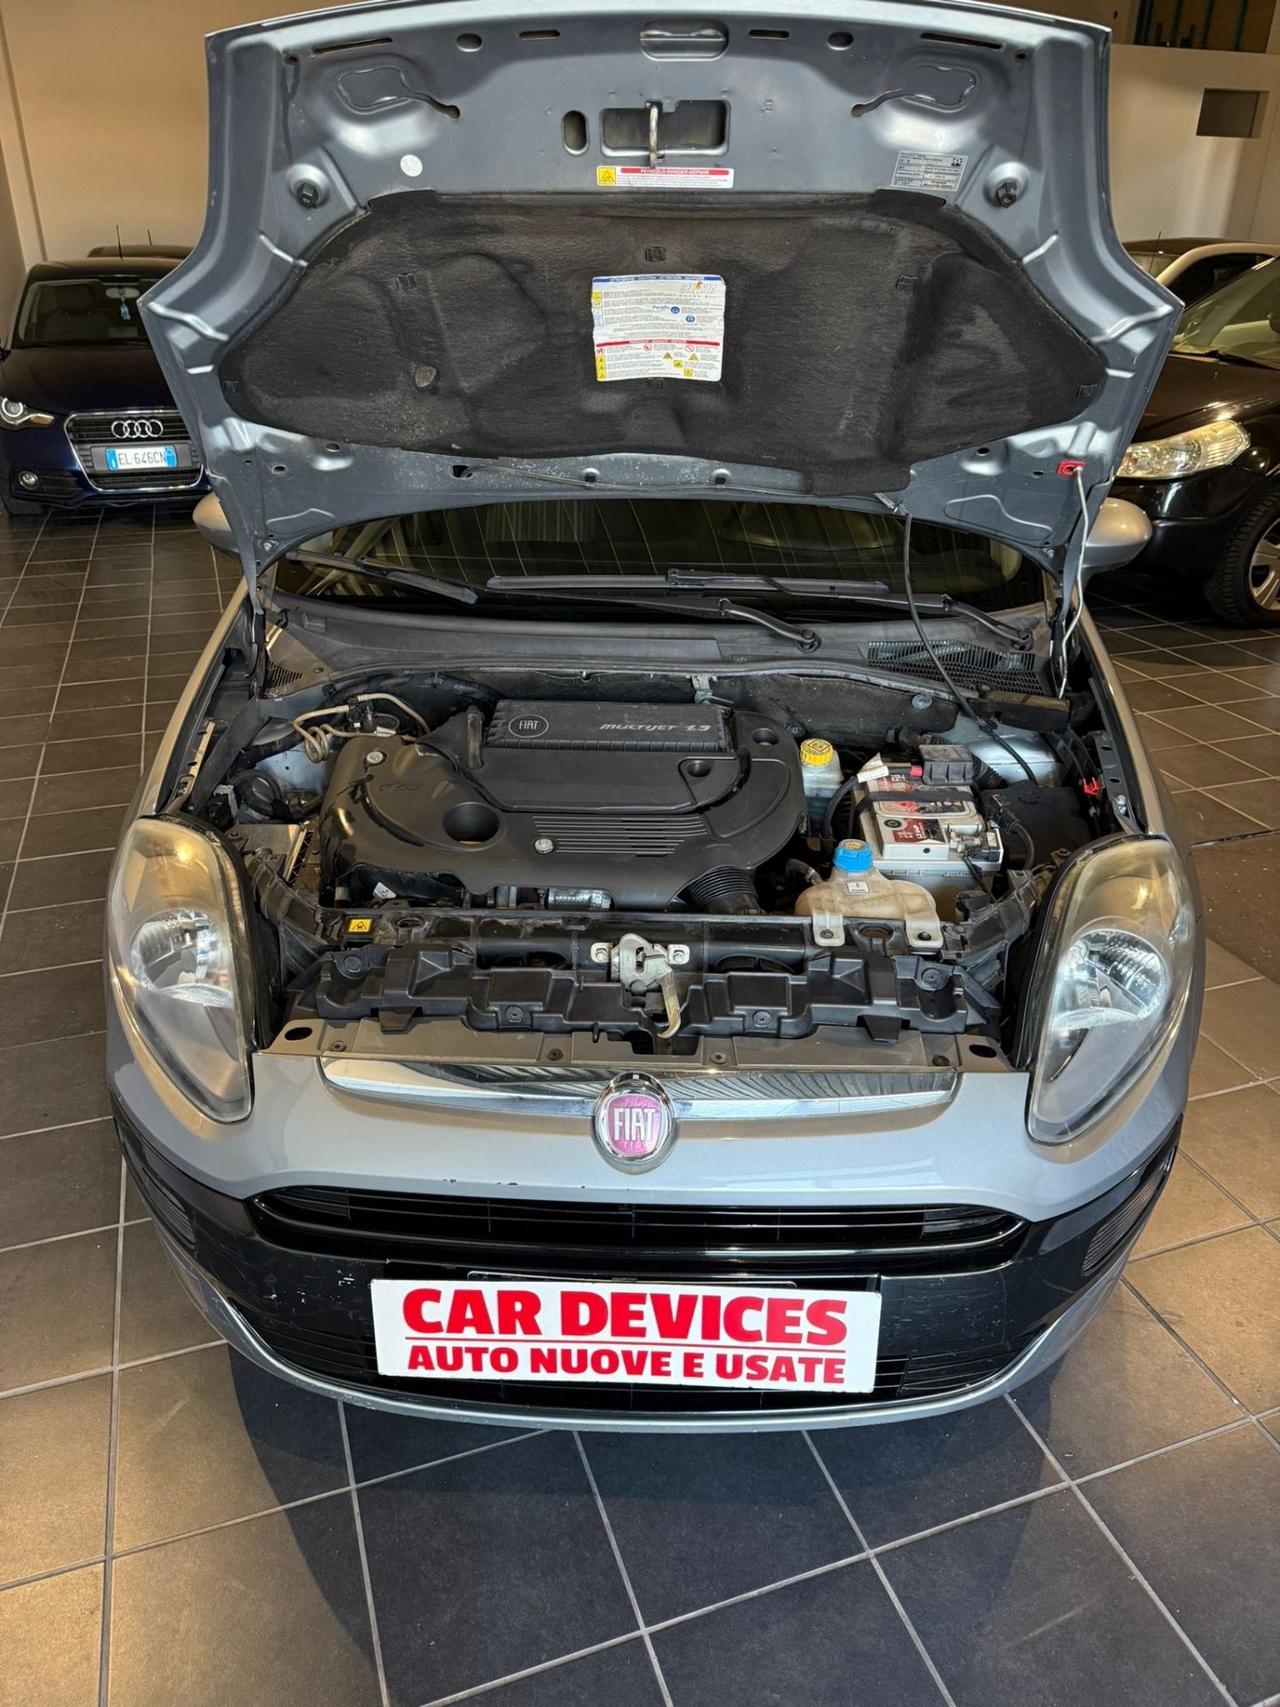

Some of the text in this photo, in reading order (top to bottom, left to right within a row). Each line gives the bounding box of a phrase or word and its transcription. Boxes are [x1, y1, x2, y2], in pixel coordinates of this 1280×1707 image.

[518, 719, 540, 730] FIAT
[684, 724, 712, 732] 1.3
[613, 1107, 657, 1142] FIAT
[403, 1288, 848, 1345] CAR DEVICES
[407, 1345, 845, 1384] AUTO NUOVE E USATE
